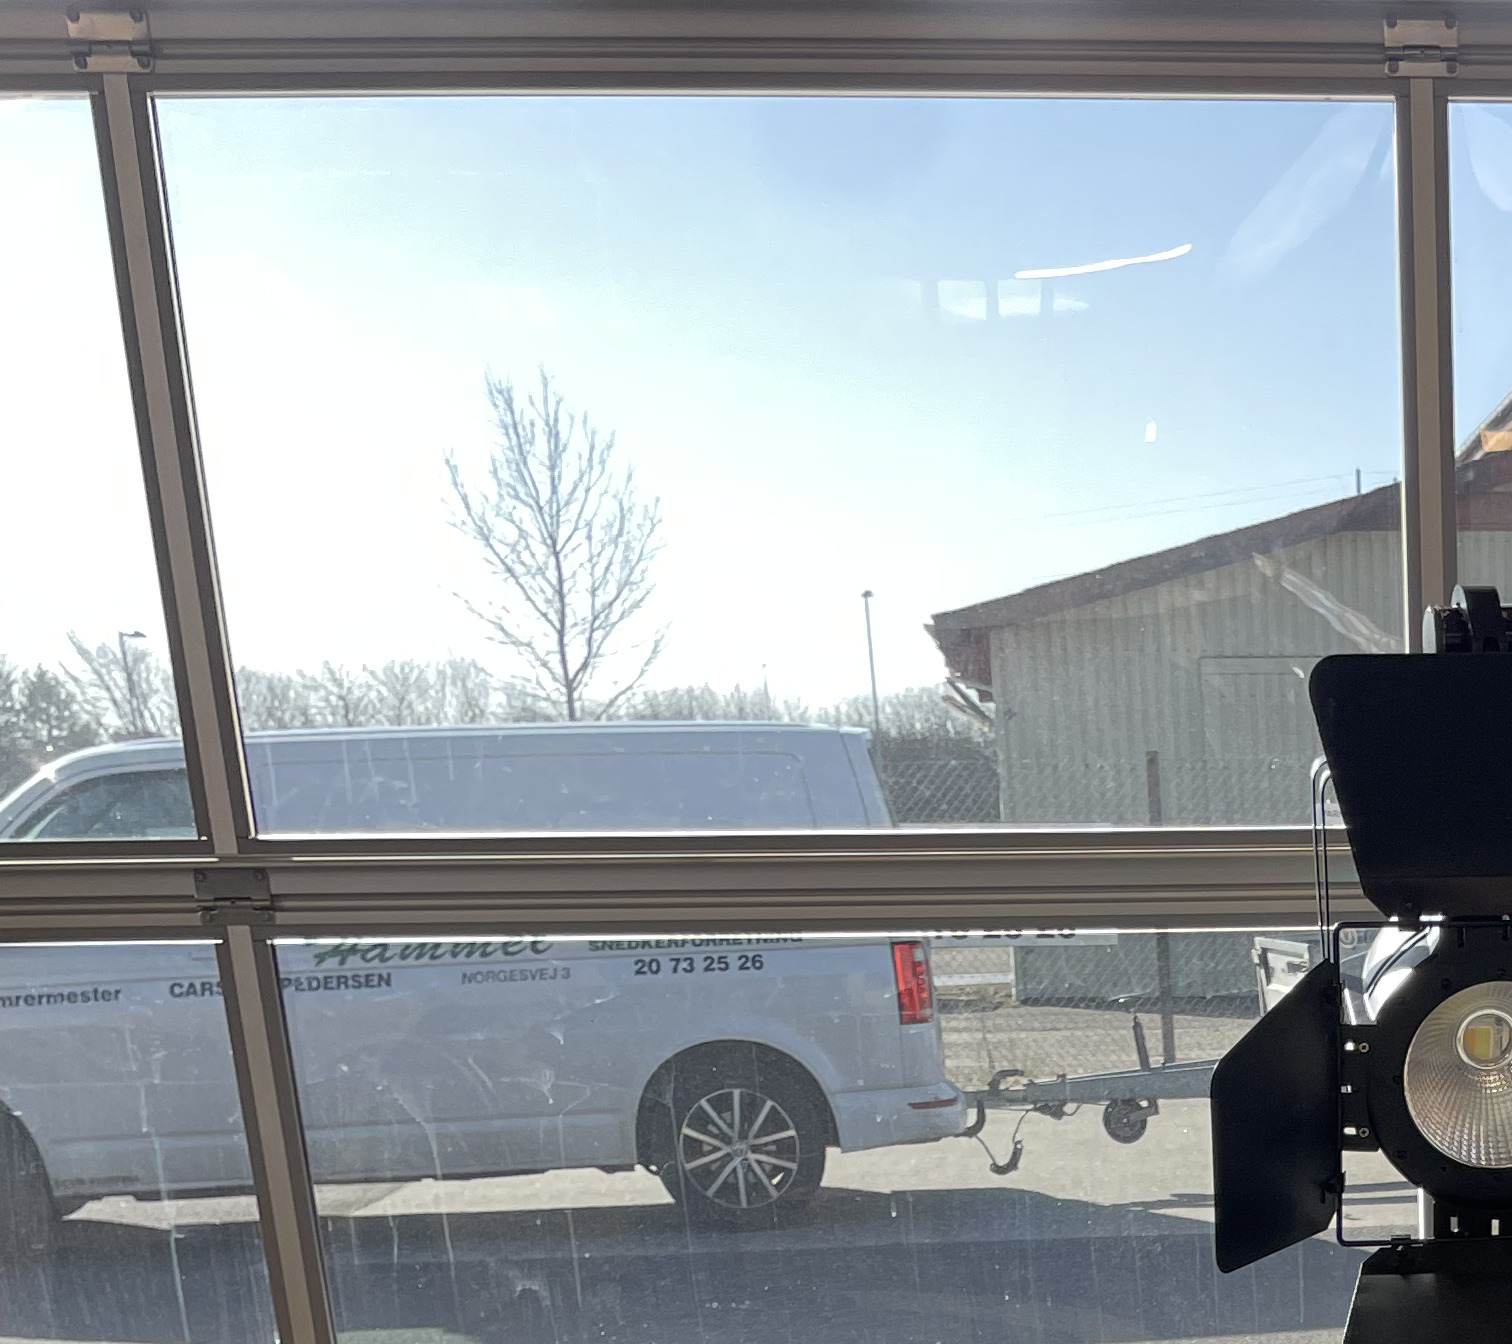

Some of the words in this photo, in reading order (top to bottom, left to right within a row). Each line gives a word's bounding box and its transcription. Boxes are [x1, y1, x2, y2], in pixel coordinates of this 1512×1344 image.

[461, 967, 558, 985] NORGESVEJ
[561, 967, 571, 980] 3
[633, 958, 661, 976] 20
[669, 957, 695, 974] 73
[703, 955, 730, 973] 25
[737, 953, 764, 971] 26
[280, 971, 393, 994] PEDERSEN
